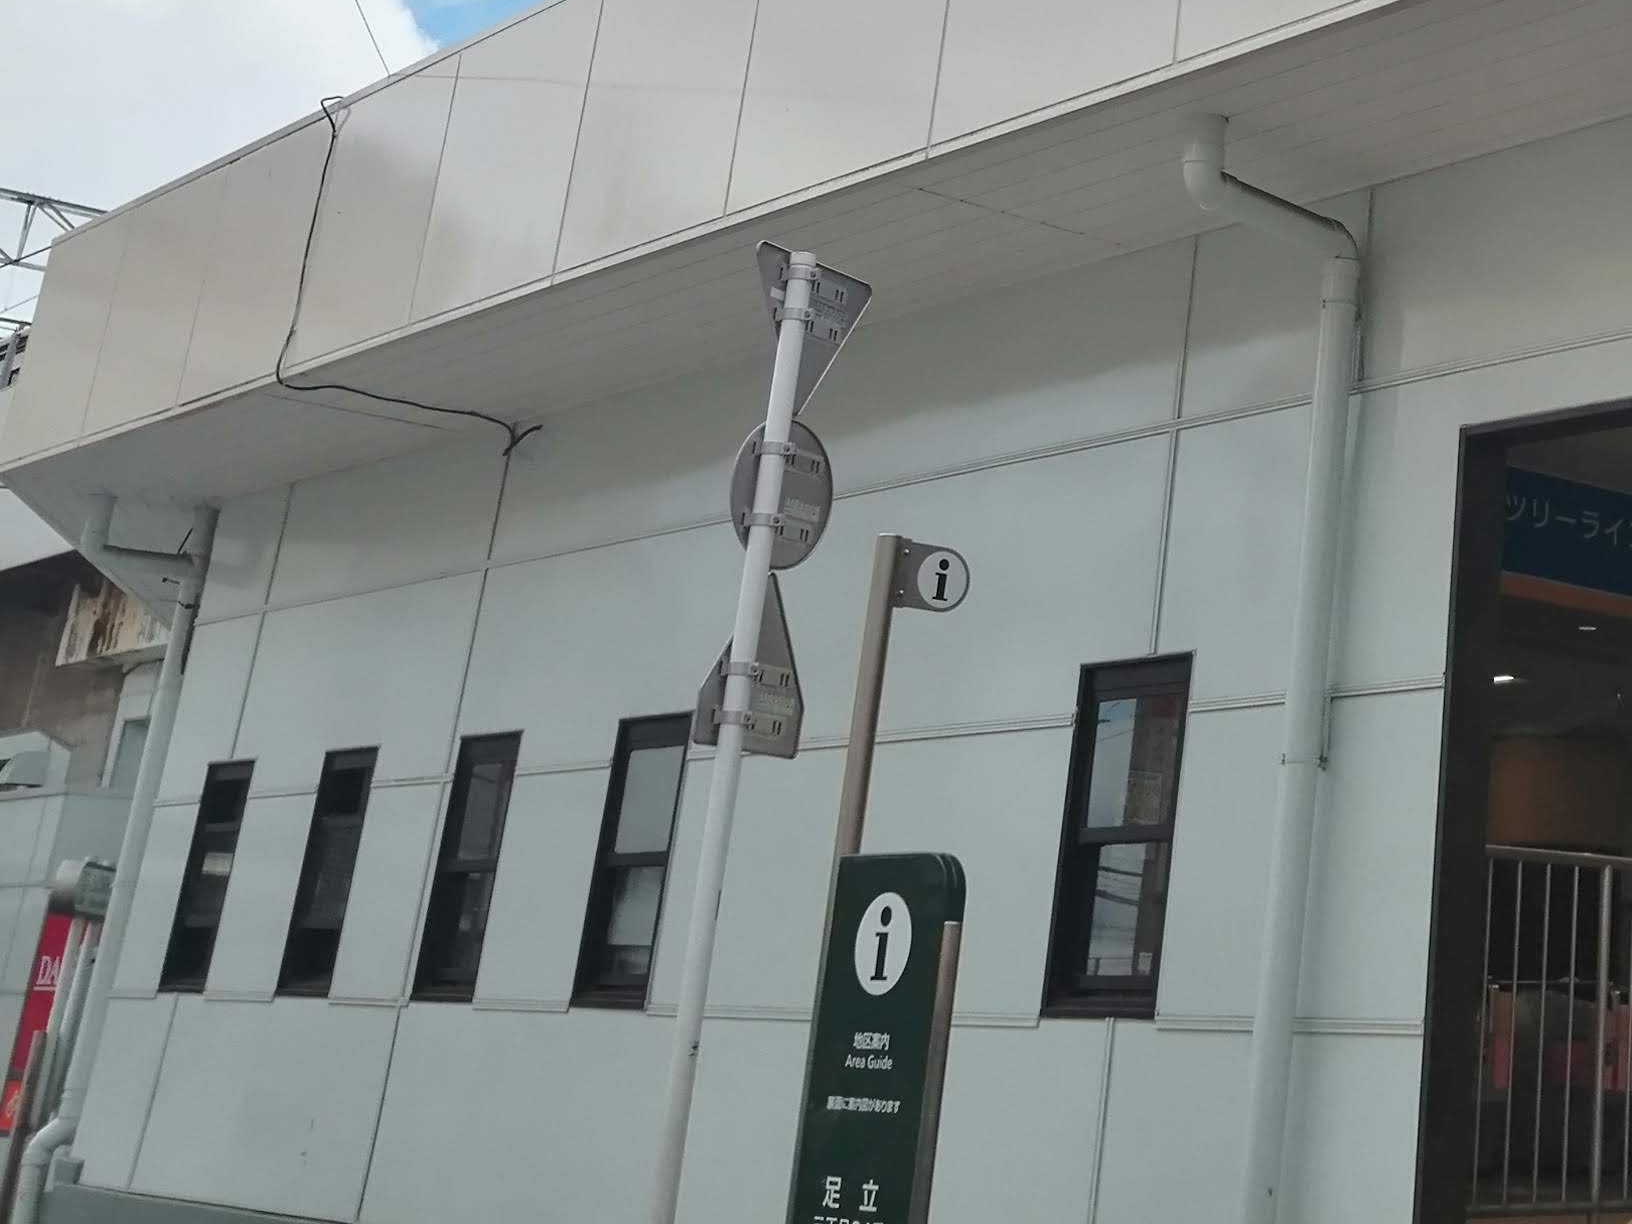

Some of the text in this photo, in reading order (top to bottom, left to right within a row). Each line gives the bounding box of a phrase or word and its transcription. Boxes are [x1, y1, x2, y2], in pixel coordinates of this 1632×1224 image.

[853, 1032, 890, 1051] 地区案内
[844, 1054, 893, 1070] Area Guide
[821, 1175, 880, 1212] 足立
